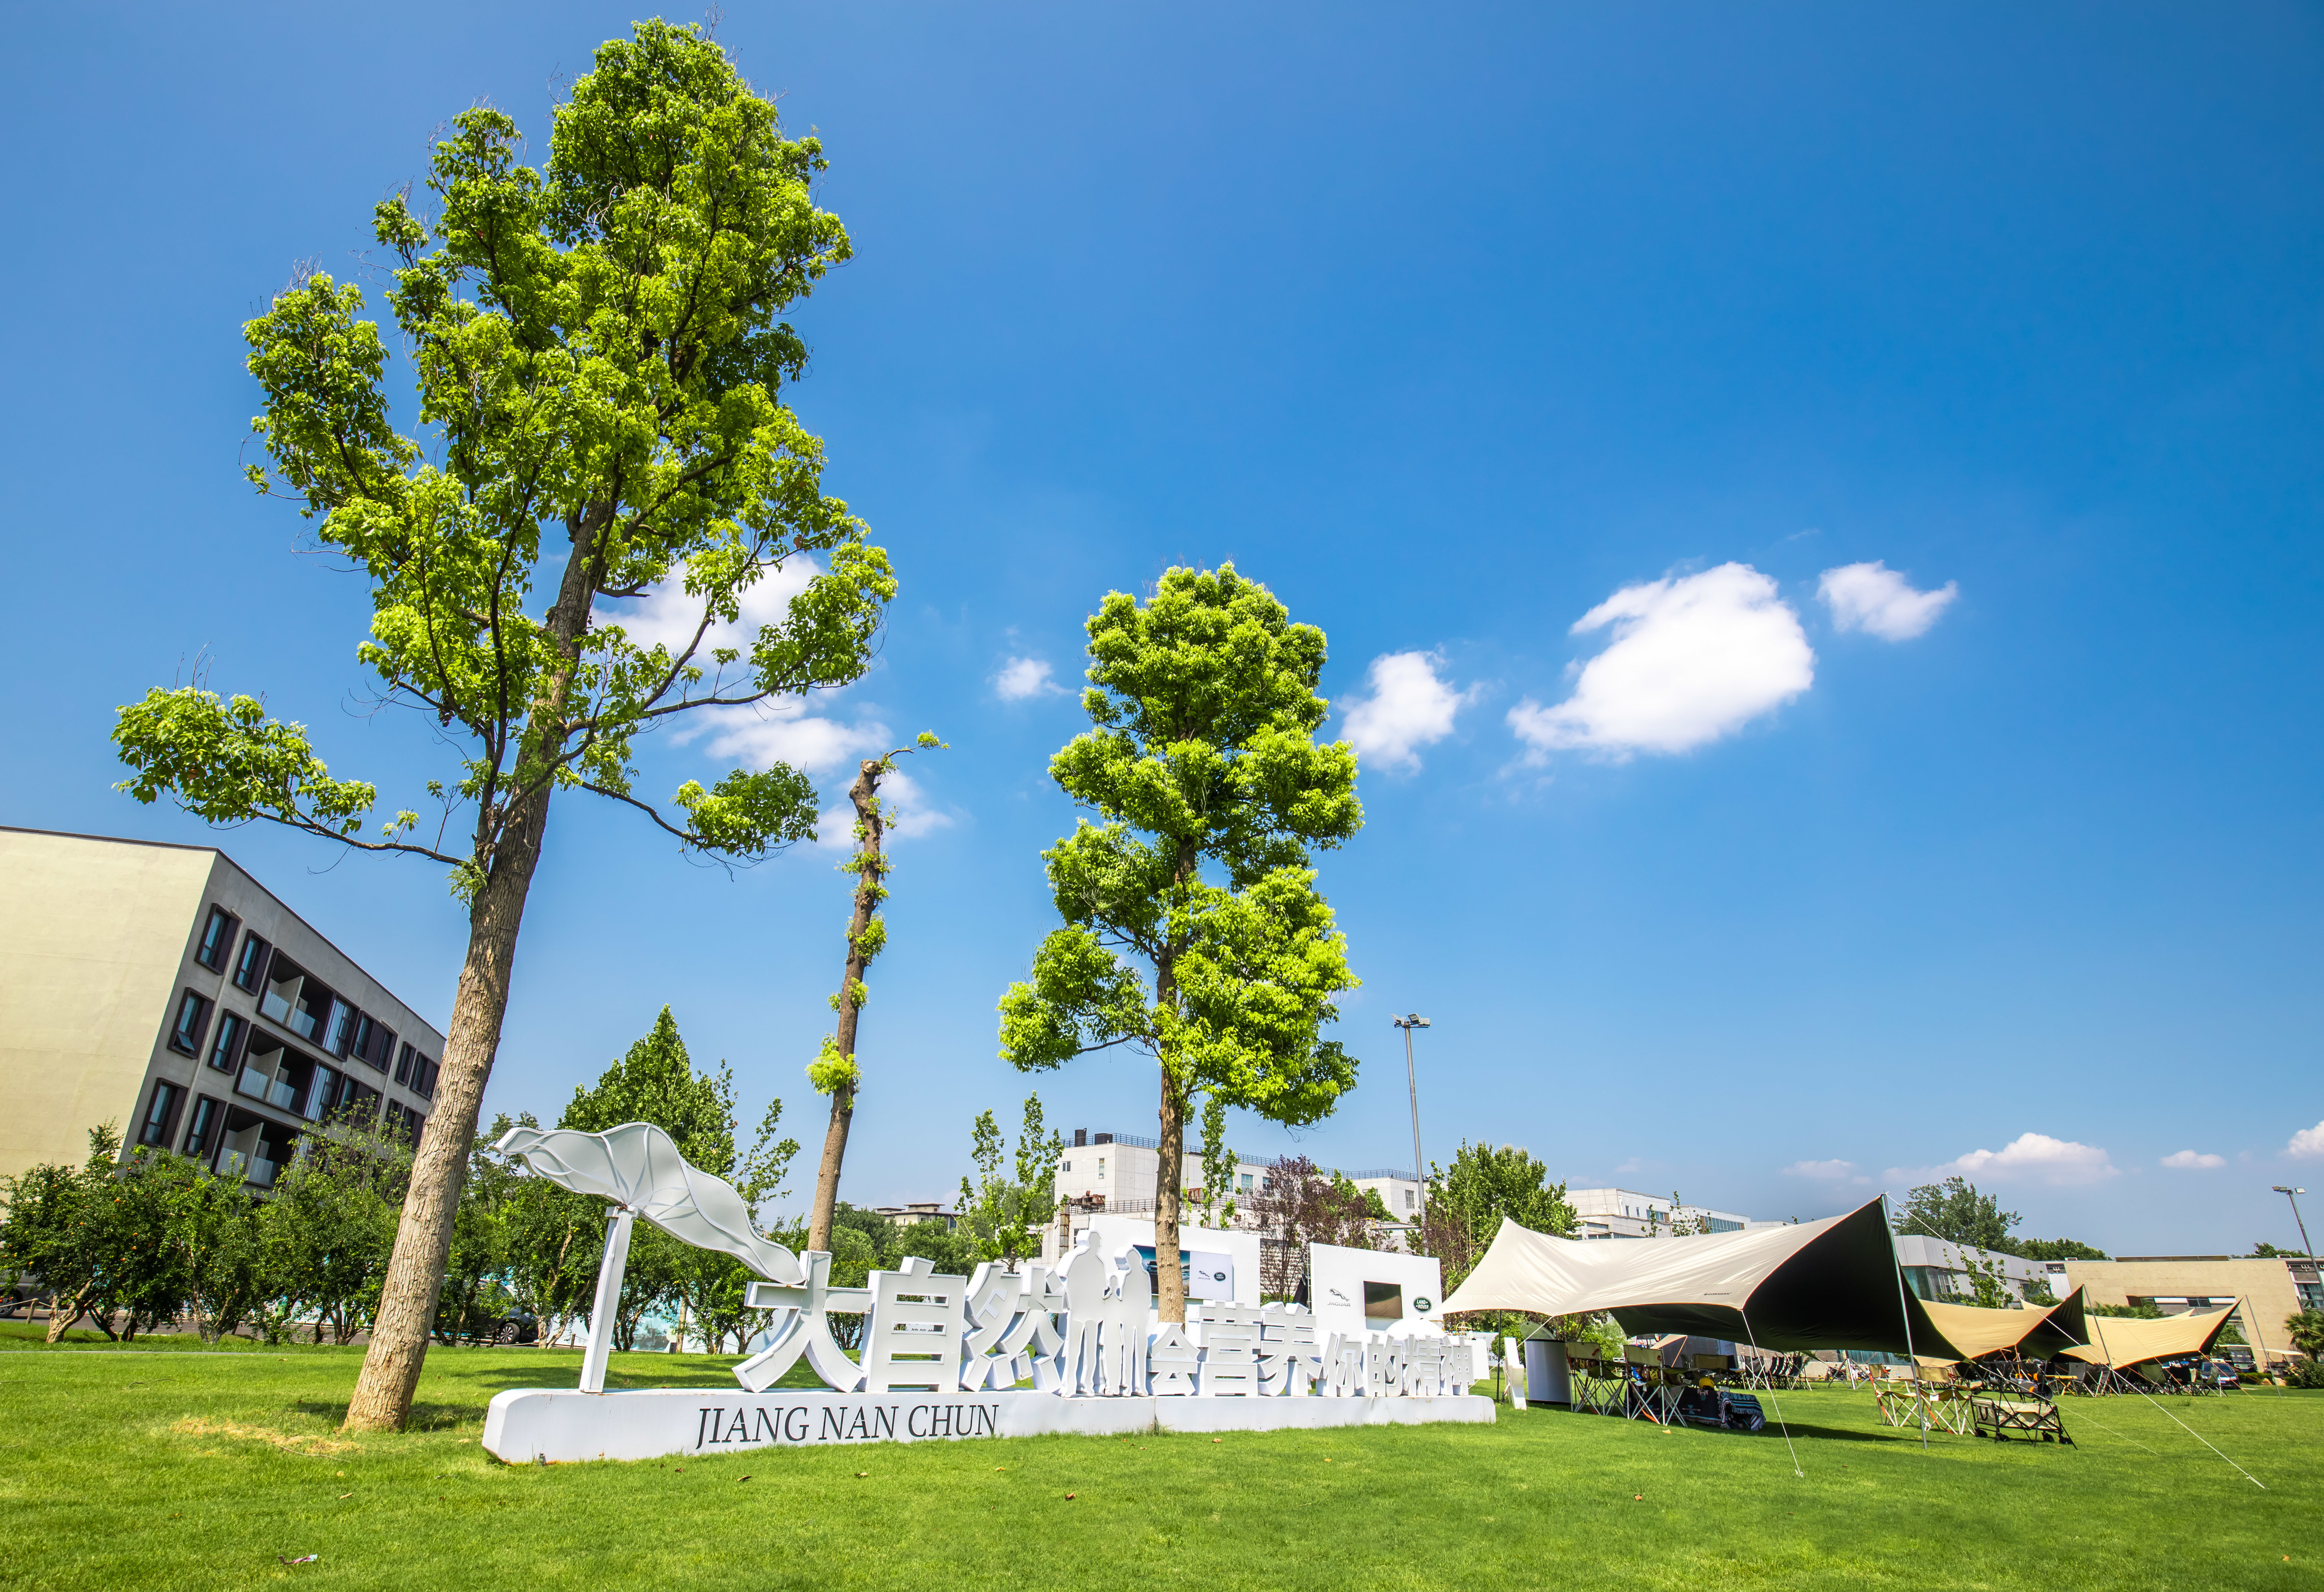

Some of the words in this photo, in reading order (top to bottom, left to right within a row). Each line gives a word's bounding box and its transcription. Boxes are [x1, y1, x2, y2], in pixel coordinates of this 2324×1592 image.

[732, 1250, 1064, 1393] 大自然
[1148, 1300, 1475, 1398] 会营养你的精神
[695, 1406, 809, 1449] JIANG
[818, 1406, 899, 1440] NAN
[908, 1404, 999, 1437] CHUN
